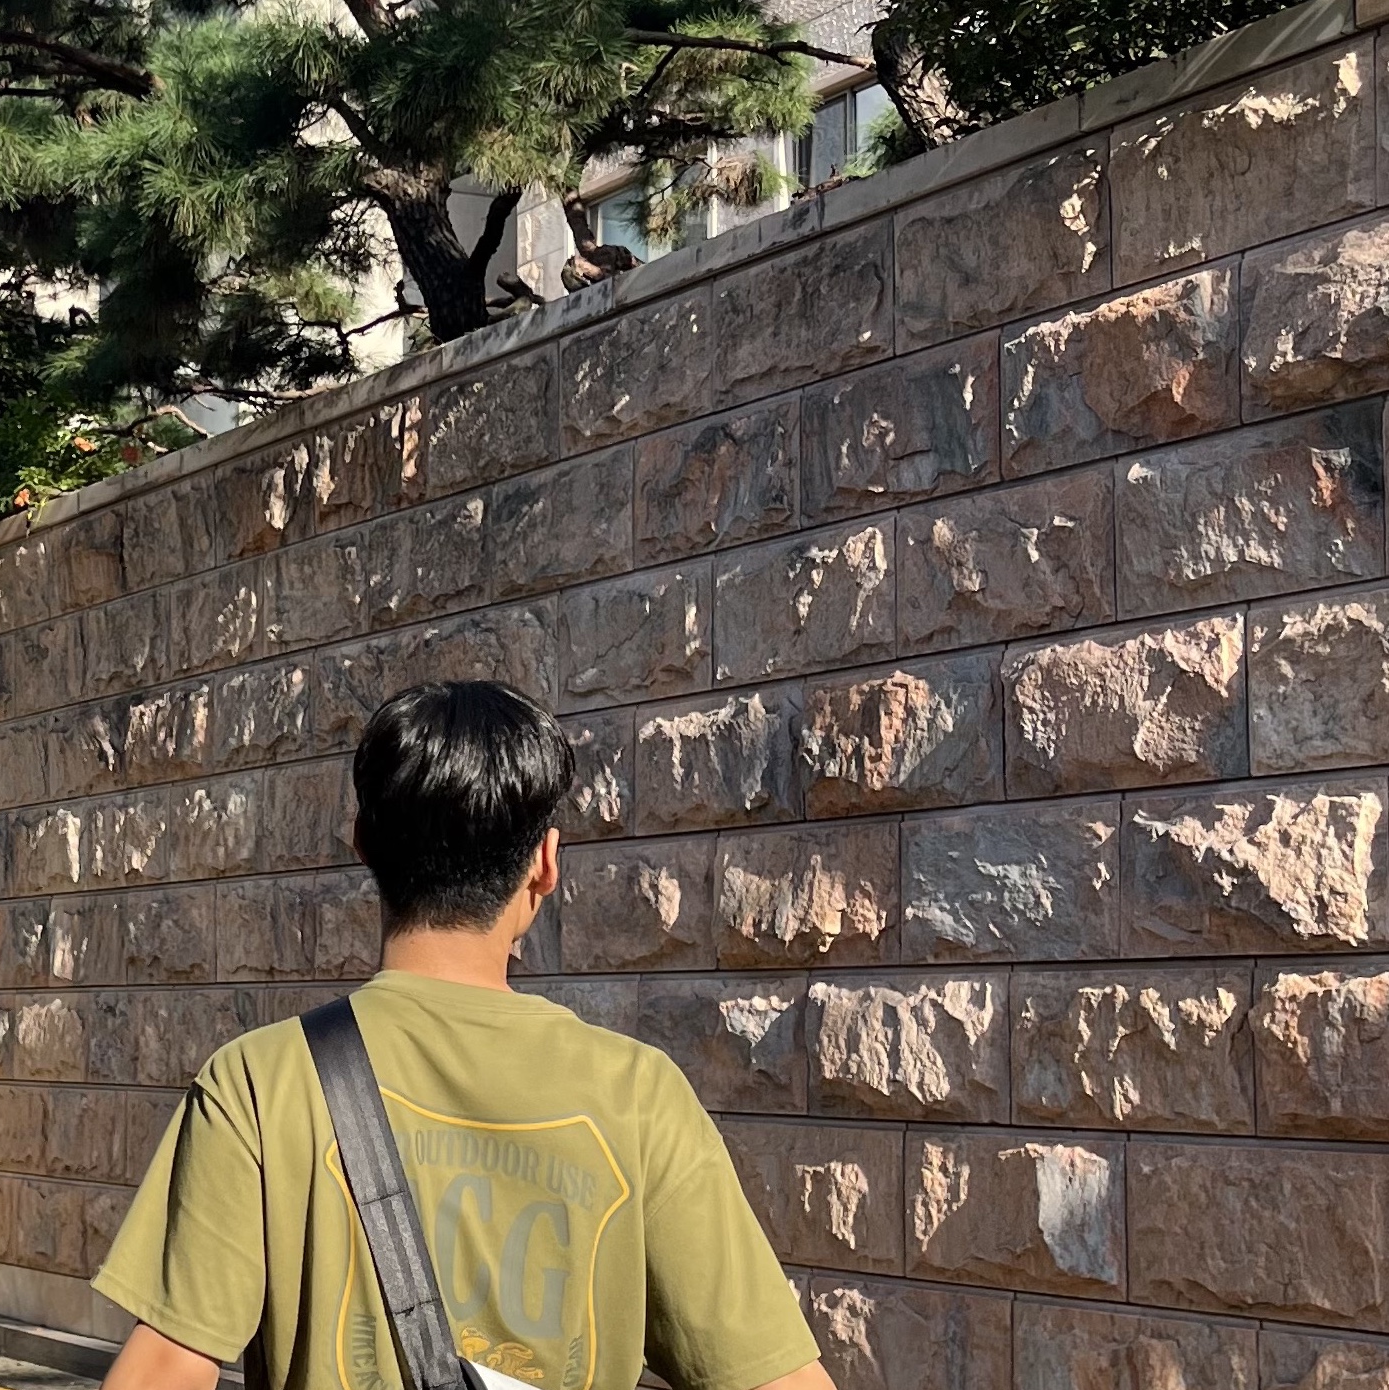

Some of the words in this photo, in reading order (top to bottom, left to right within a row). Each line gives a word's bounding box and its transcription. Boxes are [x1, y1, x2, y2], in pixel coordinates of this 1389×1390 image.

[415, 1130, 539, 1182] OUTDOOR
[546, 1154, 597, 1210] USE
[414, 1174, 571, 1339] CG
[351, 1313, 378, 1368] NIKE
